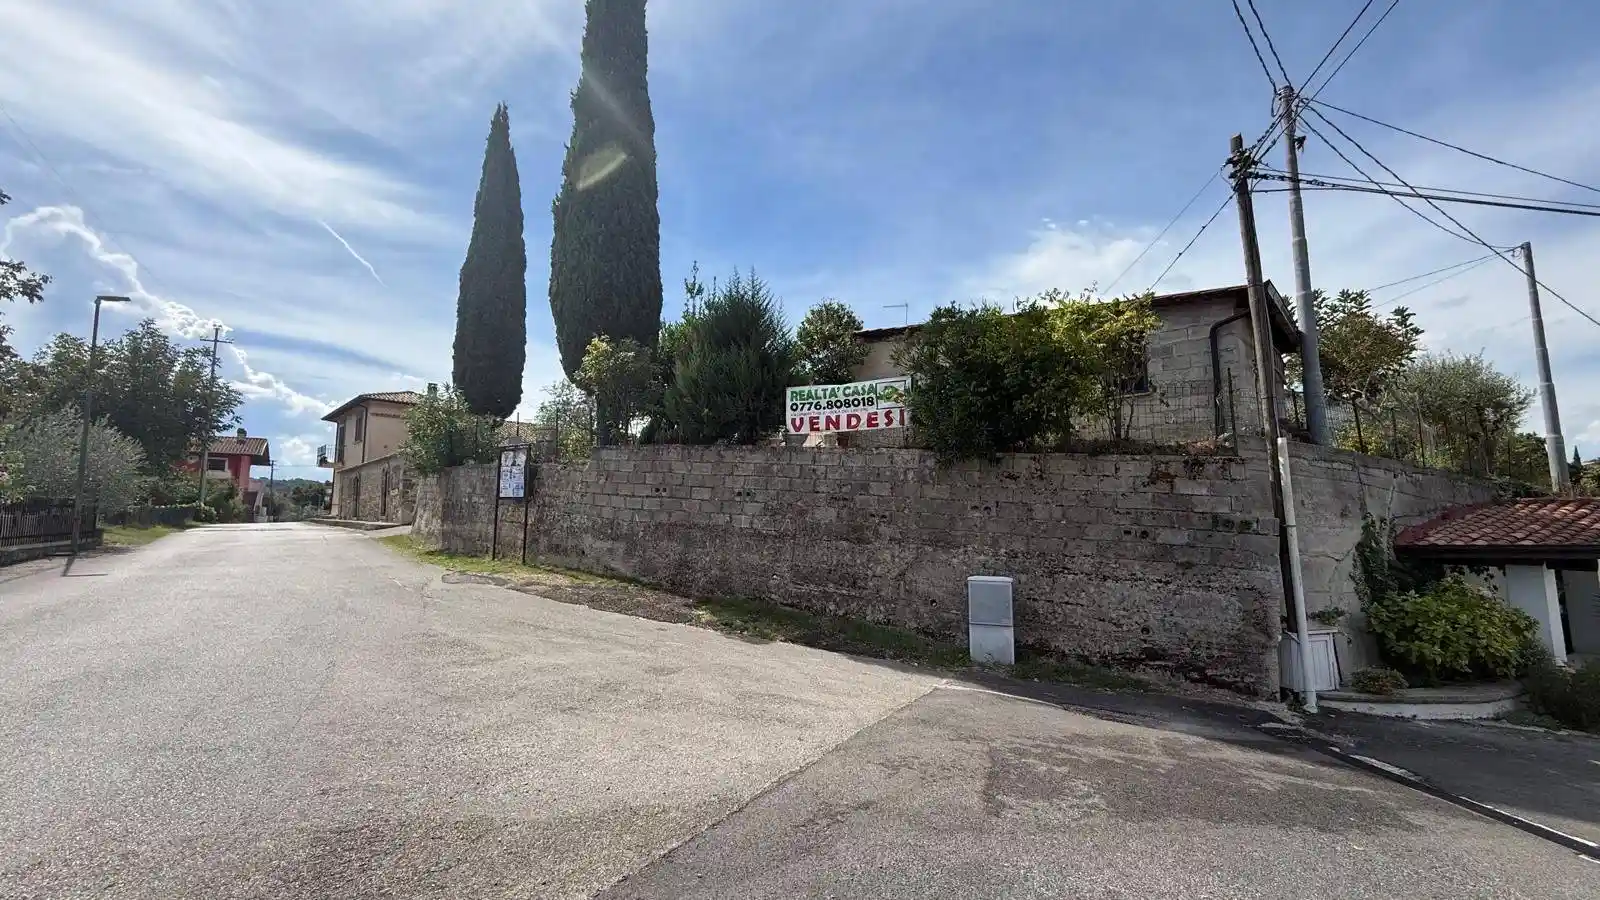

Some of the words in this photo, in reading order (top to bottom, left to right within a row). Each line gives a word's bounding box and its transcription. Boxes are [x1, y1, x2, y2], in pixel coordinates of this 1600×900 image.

[790, 386, 840, 402] REALTA'
[842, 383, 876, 398] CASA
[790, 396, 875, 411] 0776.808018
[791, 409, 906, 432] VENDESI
